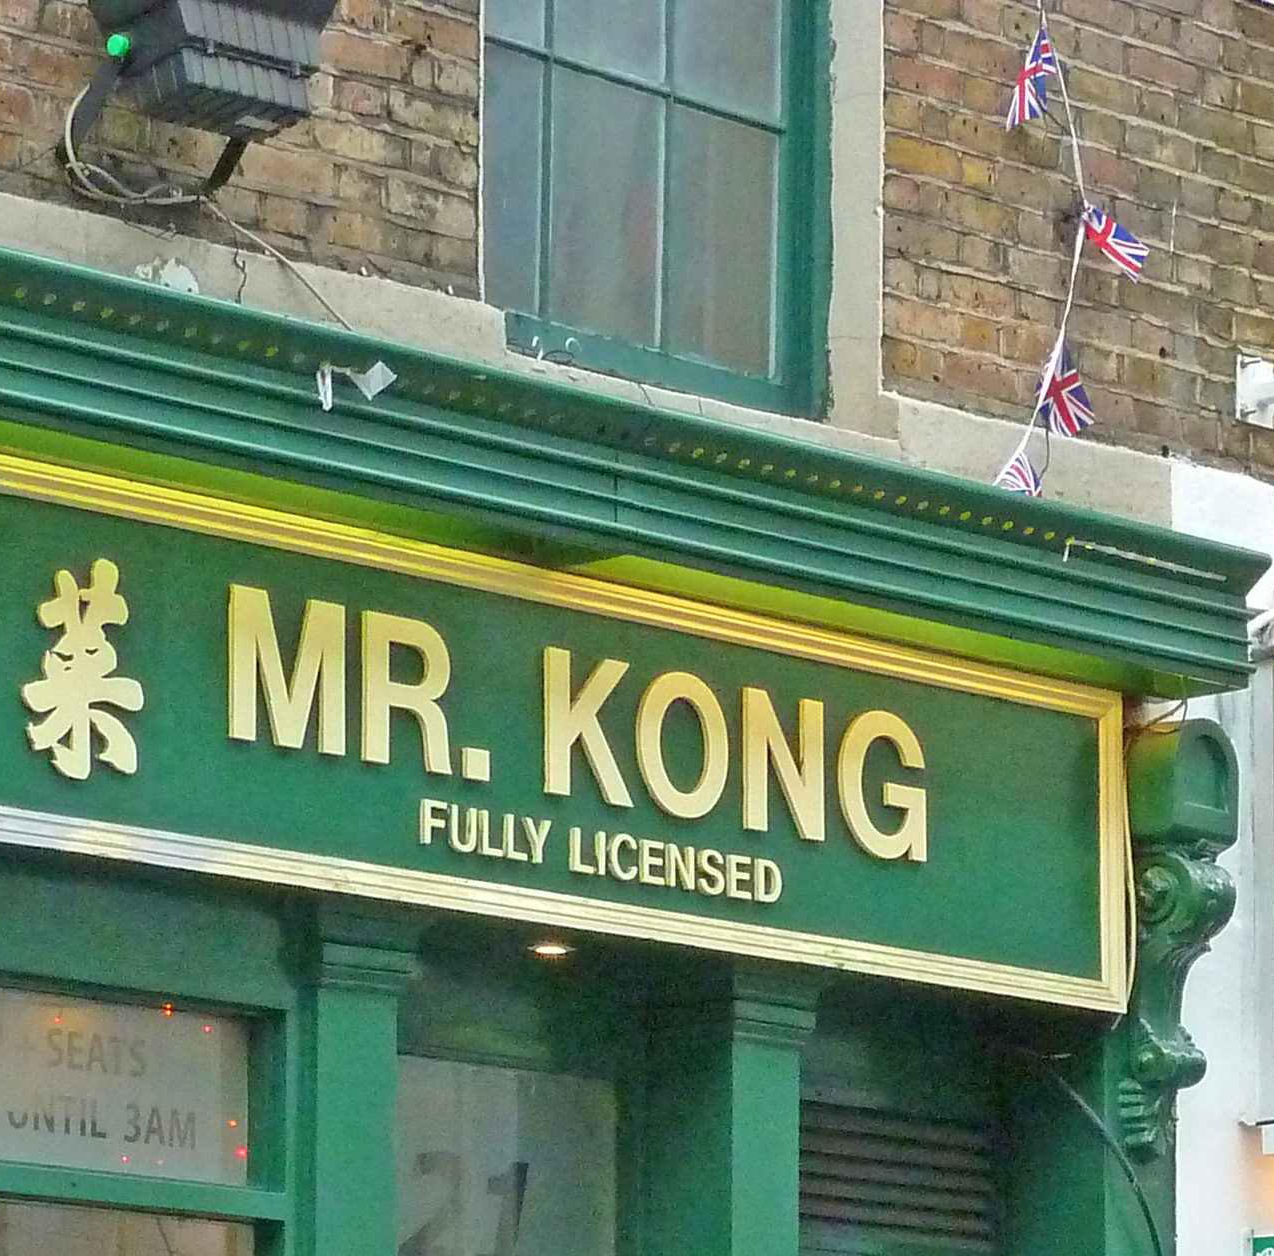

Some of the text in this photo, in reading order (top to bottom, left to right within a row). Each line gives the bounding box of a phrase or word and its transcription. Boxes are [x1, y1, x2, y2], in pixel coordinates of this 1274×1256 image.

[229, 583, 928, 863] MR. KONG
[419, 798, 783, 904] FULLY LICENSED
[46, 1029, 146, 1077] SEATS
[8, 1094, 107, 1139] UNTIL
[124, 1103, 197, 1150] 3AM
